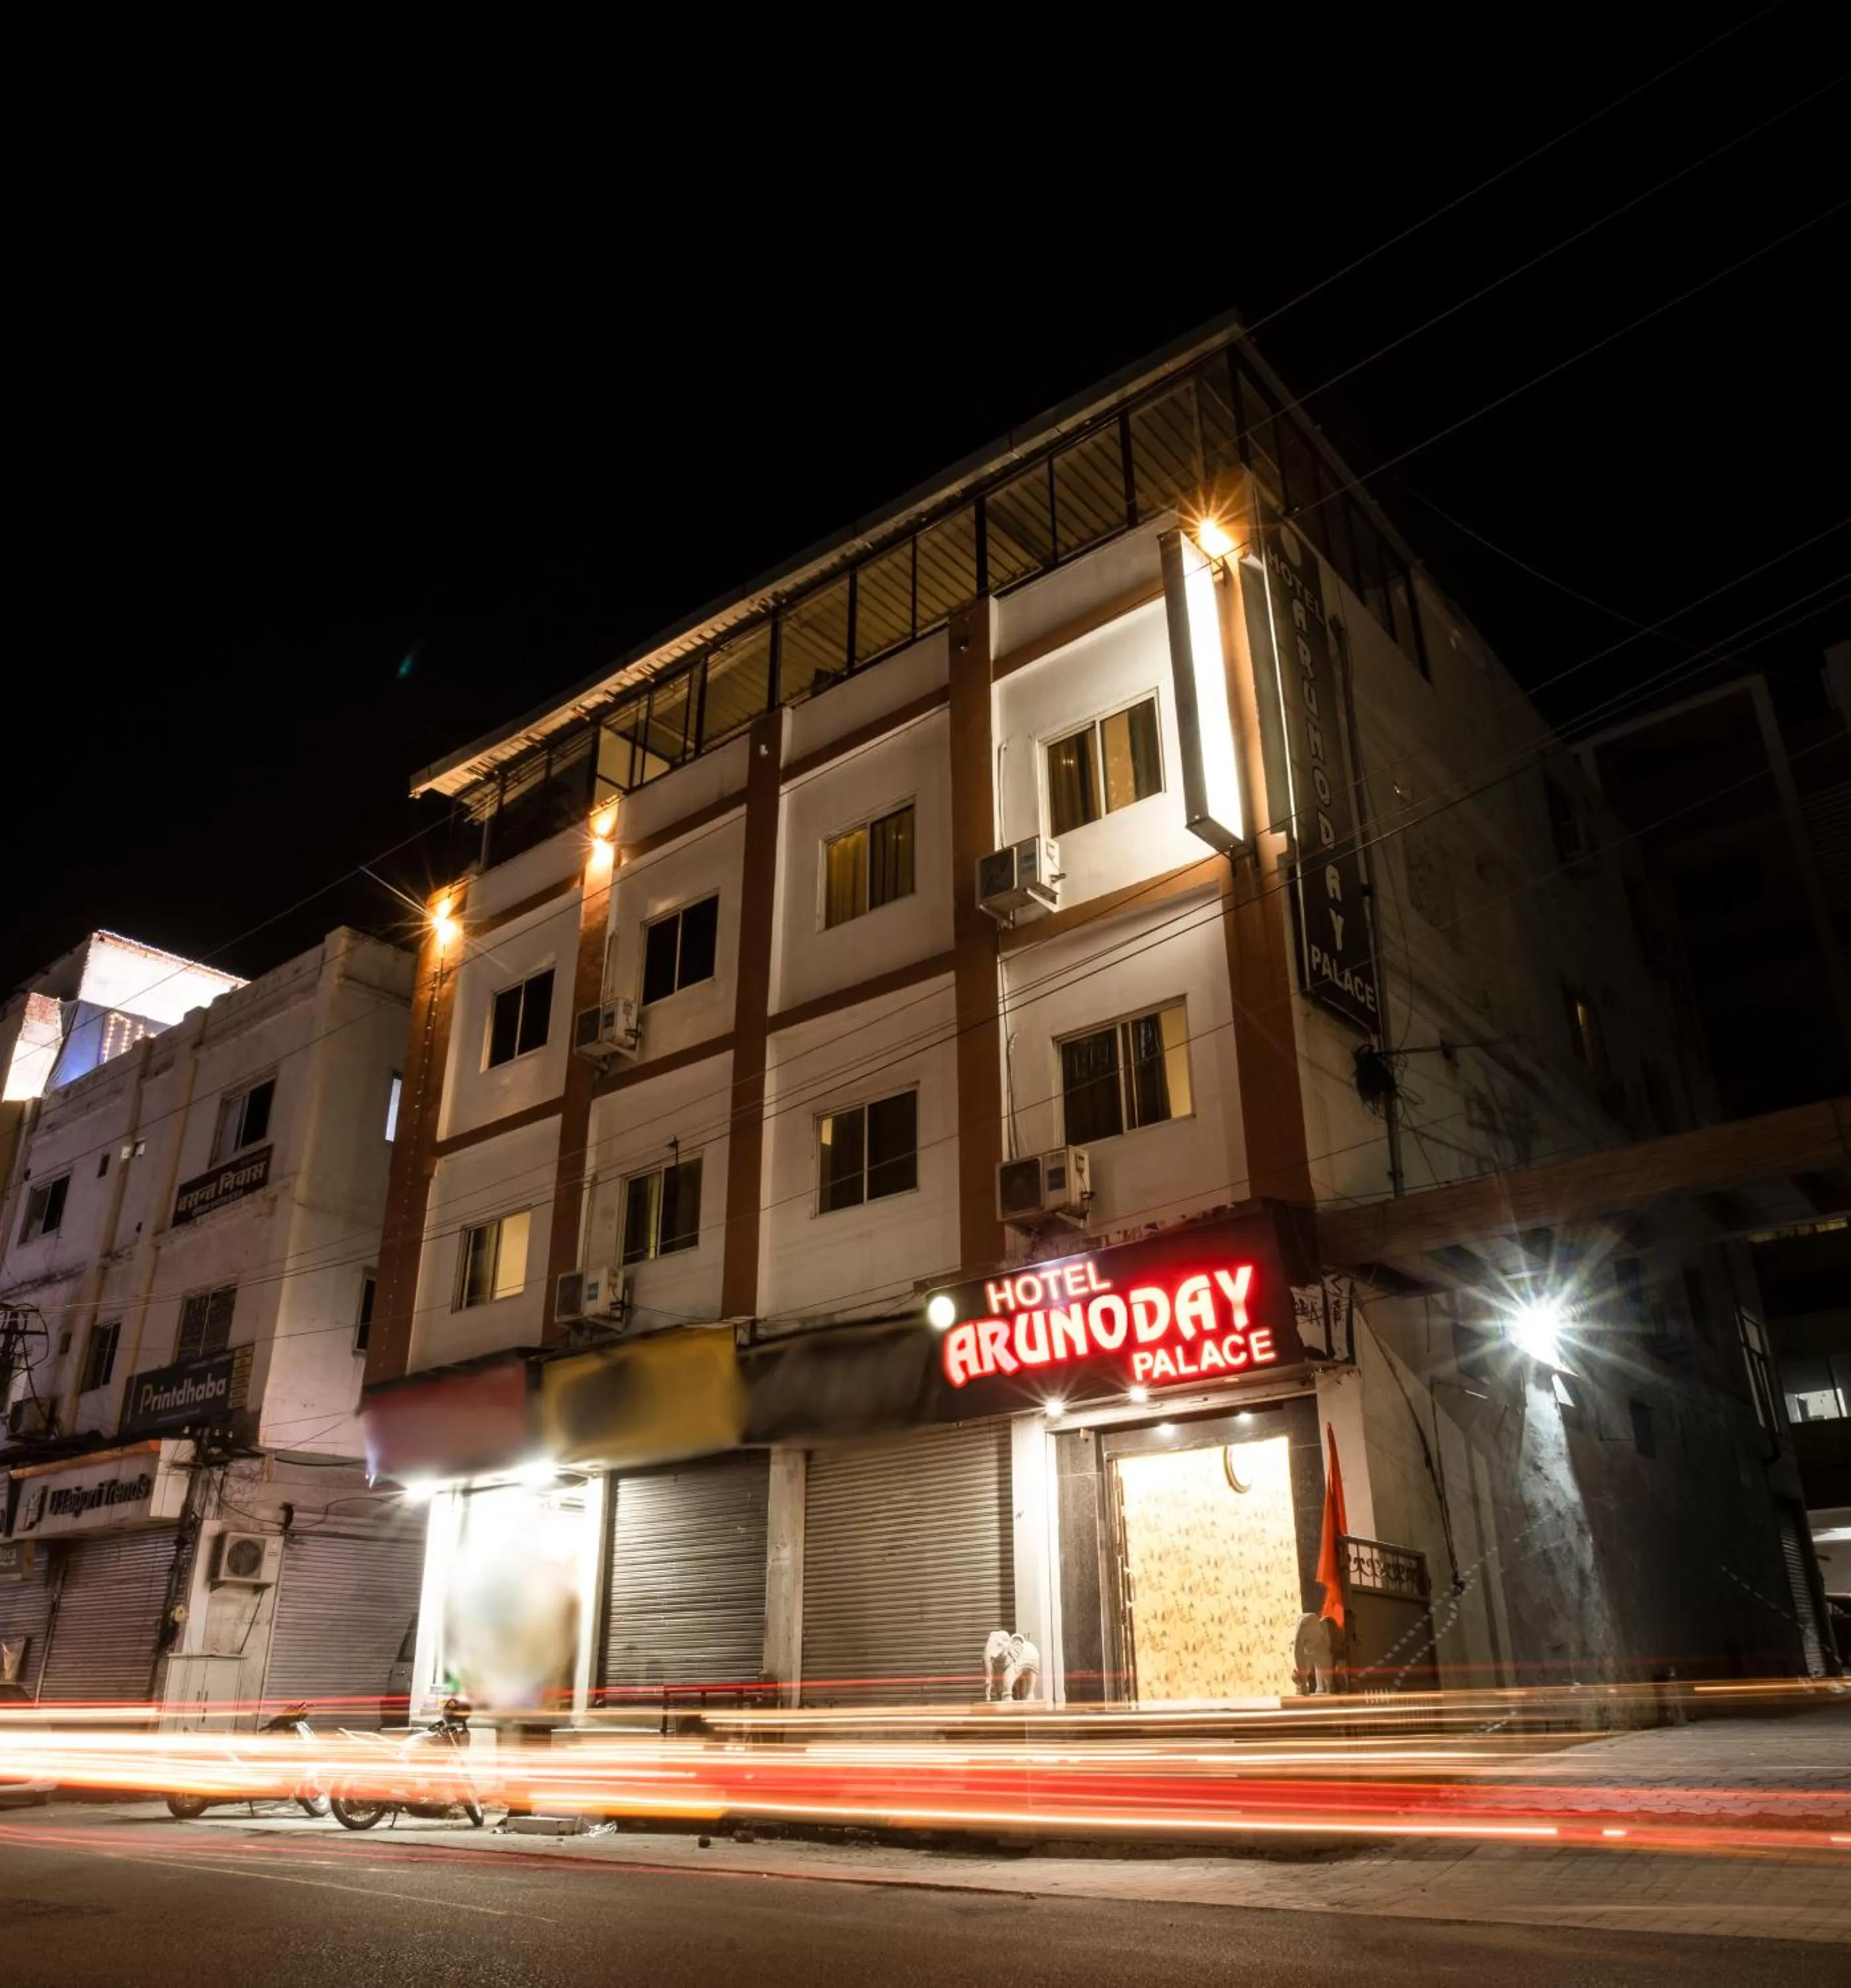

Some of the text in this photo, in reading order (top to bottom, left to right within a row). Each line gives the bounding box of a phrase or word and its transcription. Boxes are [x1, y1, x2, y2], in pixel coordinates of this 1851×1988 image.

[1266, 545, 1326, 626] HOTEL
[1292, 598, 1345, 951] ARUNODAY
[1310, 943, 1377, 1013] PALACE
[986, 1261, 1112, 1314] HOTEL
[945, 1265, 1254, 1386] ARUNODAY
[1132, 1330, 1276, 1381] PALACE
[139, 1372, 227, 1415] Printdhaba
